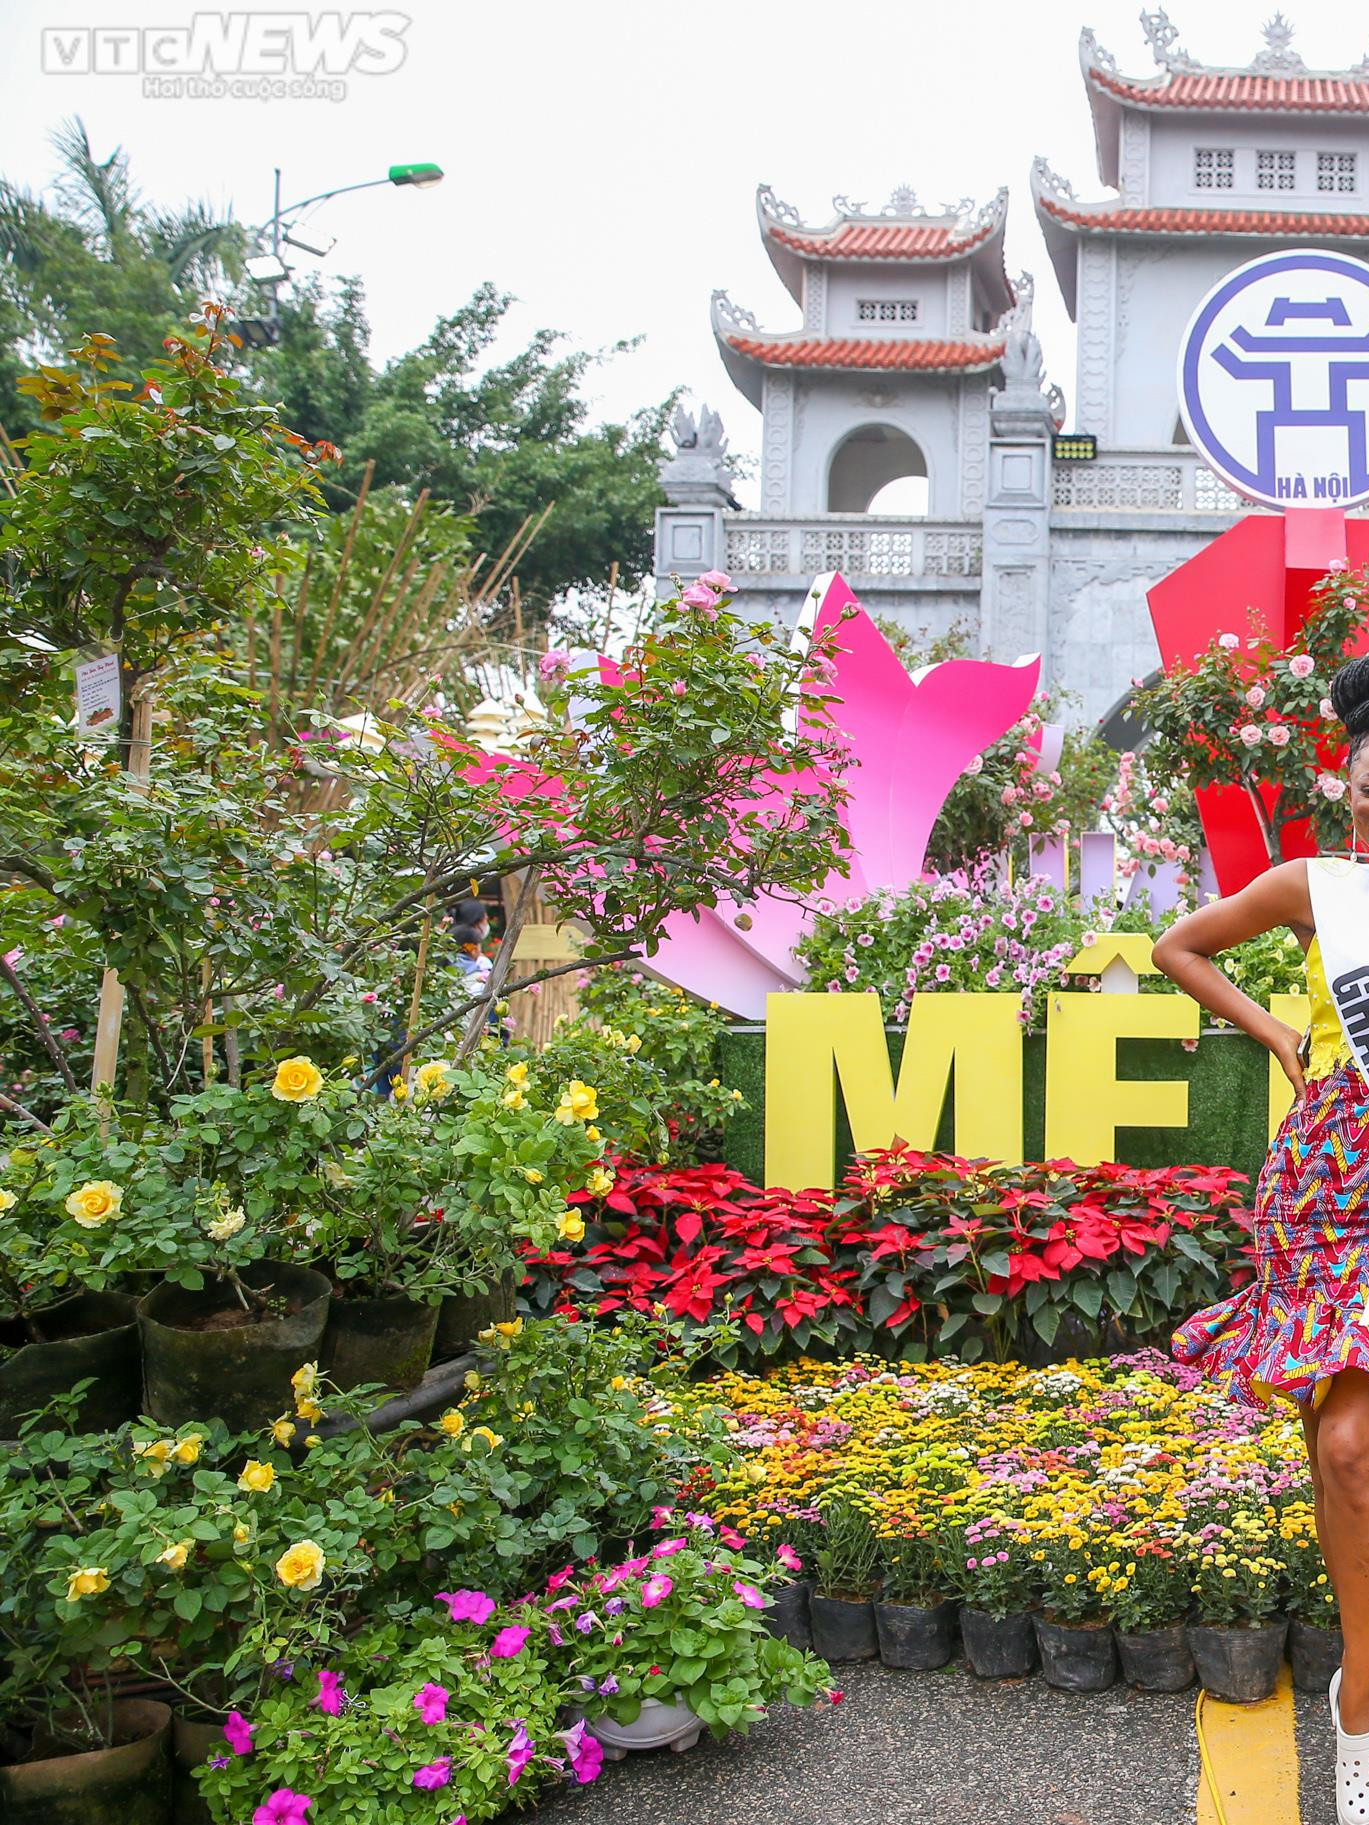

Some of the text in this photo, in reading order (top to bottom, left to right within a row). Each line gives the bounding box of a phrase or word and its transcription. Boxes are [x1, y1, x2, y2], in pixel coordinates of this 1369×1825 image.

[1277, 472, 1348, 503] HÀ NỘI
[764, 932, 1200, 1200] MÊ
